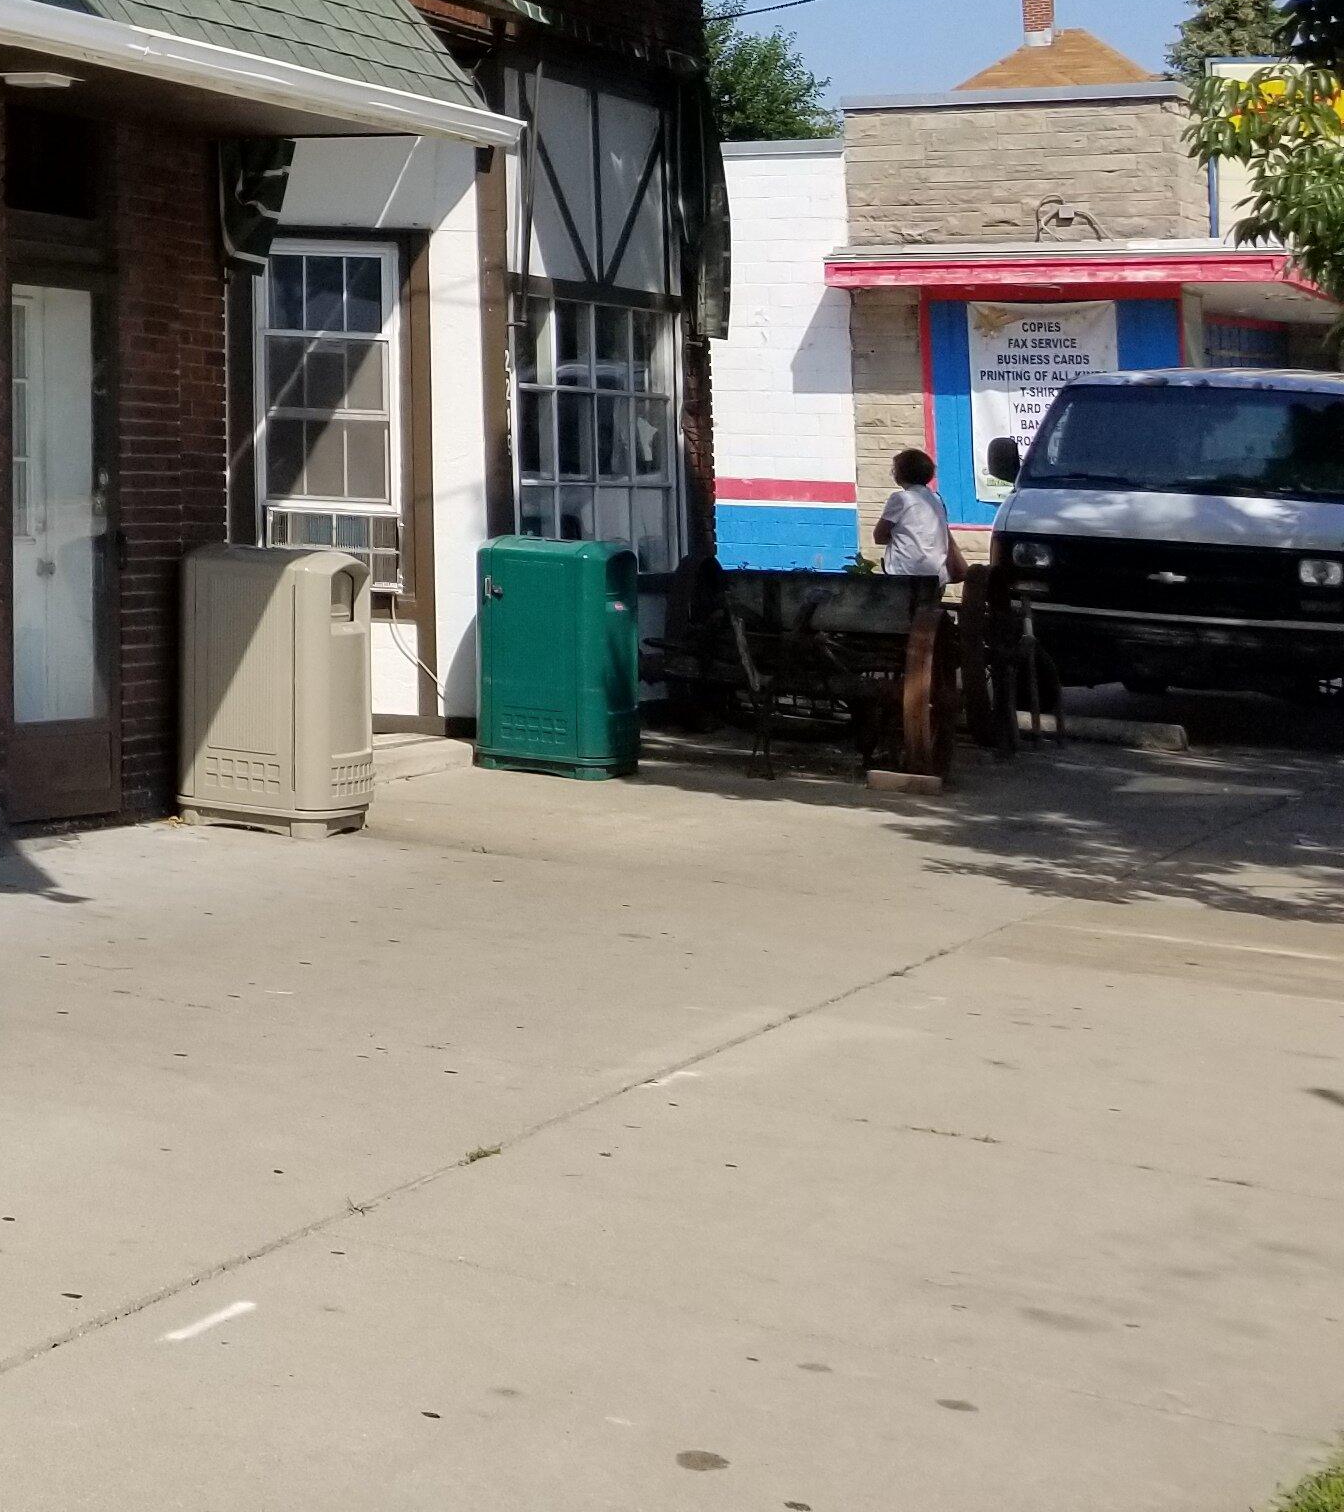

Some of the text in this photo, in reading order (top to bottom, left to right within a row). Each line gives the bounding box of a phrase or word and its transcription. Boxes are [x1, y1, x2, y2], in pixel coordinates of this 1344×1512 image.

[1021, 321, 1061, 333] COPIES
[1008, 338, 1077, 349] FAX SERVICE
[997, 354, 1090, 365] BUSINESS CARDS
[980, 370, 1031, 381] PRINTING
[1034, 370, 1047, 381] OF
[1051, 370, 1069, 381] ALL
[1013, 403, 1041, 414] YARD
